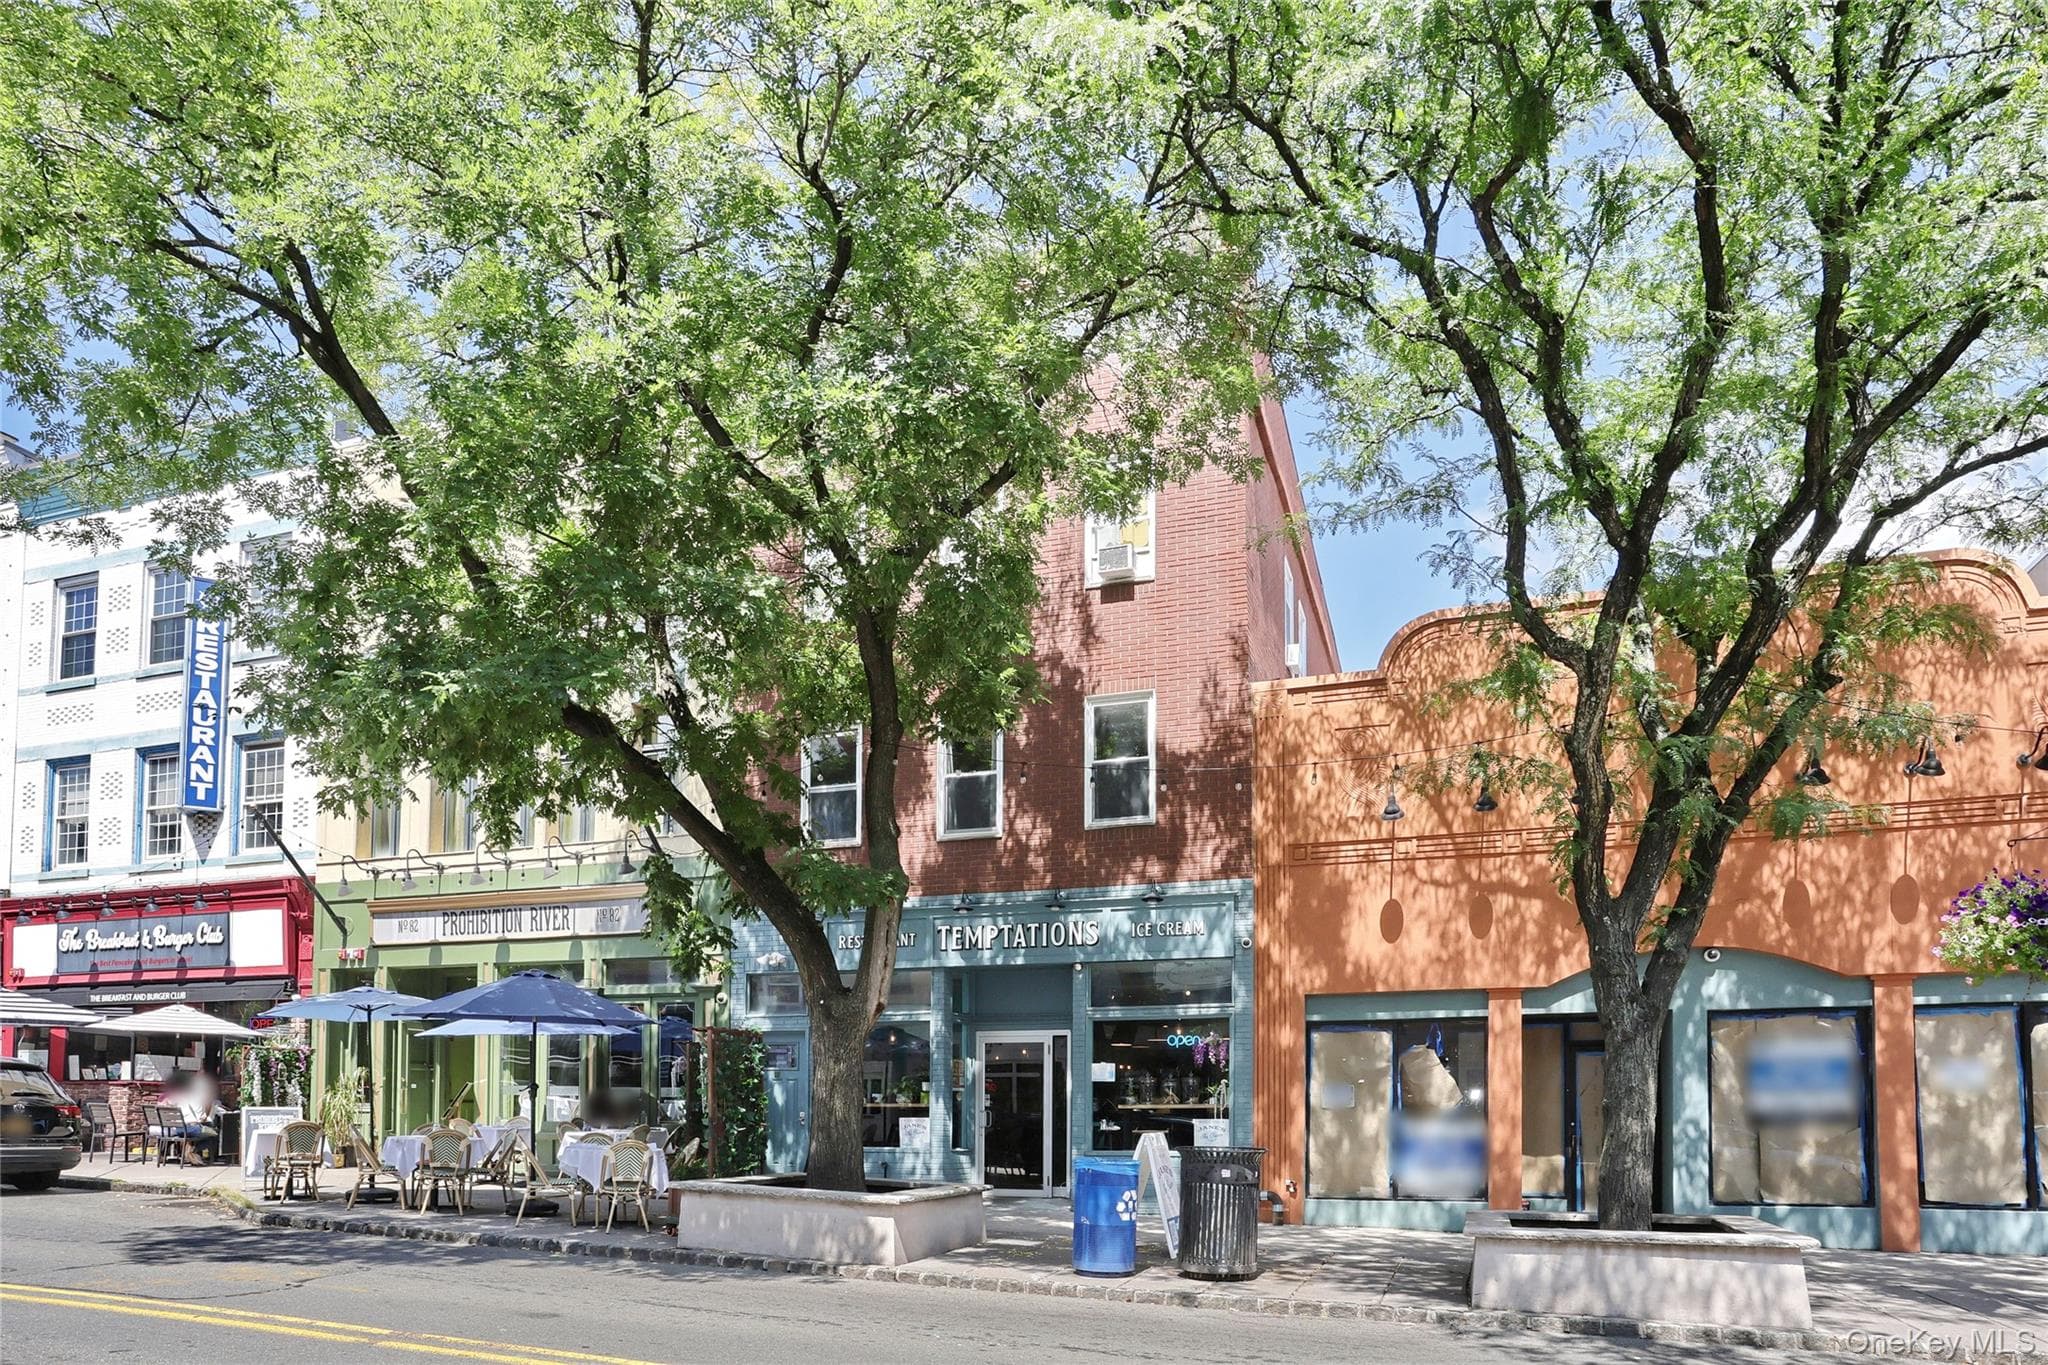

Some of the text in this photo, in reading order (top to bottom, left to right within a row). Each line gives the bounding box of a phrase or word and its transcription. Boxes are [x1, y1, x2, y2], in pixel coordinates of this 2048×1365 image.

[189, 618, 220, 800] RESTAURANT
[442, 905, 570, 936] PROHIBITION RIVER
[937, 920, 1099, 951] TEMPTATIONS
[1131, 920, 1204, 938] ICE CREAM
[59, 926, 84, 953] The
[86, 928, 140, 951] Breakfast
[153, 925, 194, 953] Burger
[196, 921, 225, 945] Club
[90, 991, 187, 1003] THE BREAKFAST AND BURGER CLUB
[1167, 1034, 1203, 1048] open
